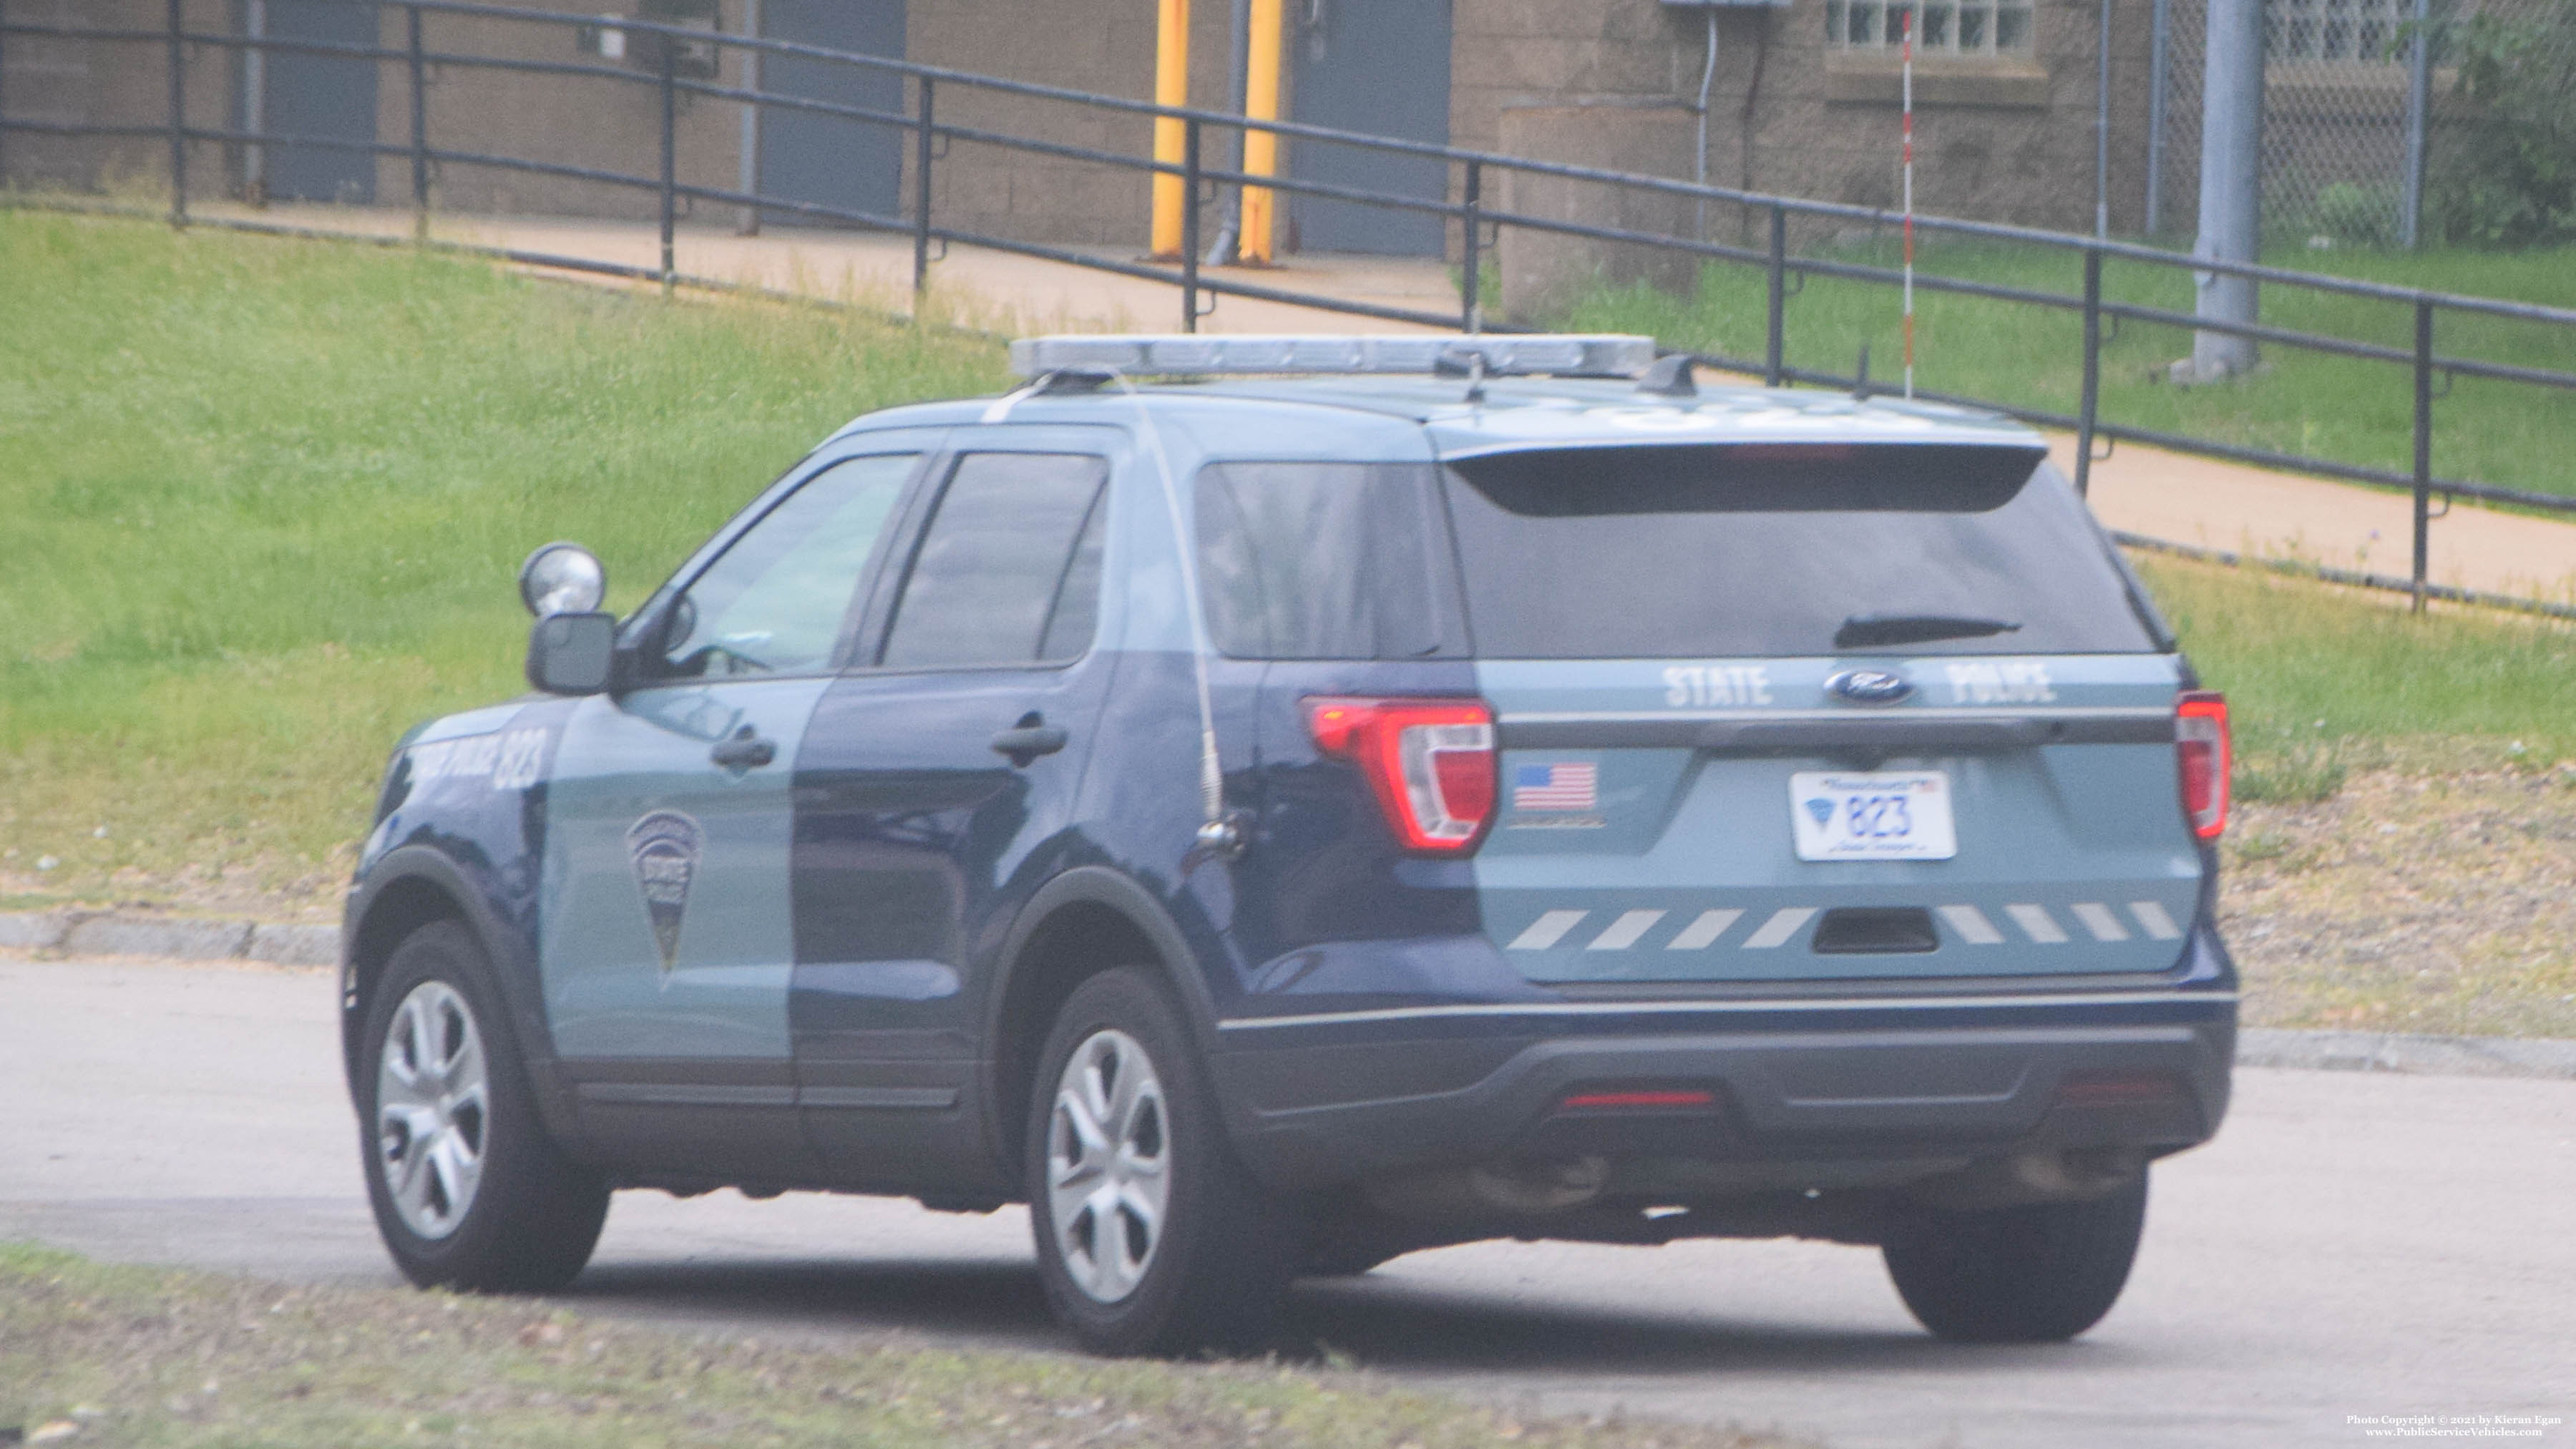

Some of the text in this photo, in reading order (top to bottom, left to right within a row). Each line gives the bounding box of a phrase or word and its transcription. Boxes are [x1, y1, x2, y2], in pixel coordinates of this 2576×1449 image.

[1663, 665, 1774, 706] STATE
[1944, 663, 2057, 703] POLICE
[493, 726, 547, 790] 823
[1847, 795, 1912, 837] 823
